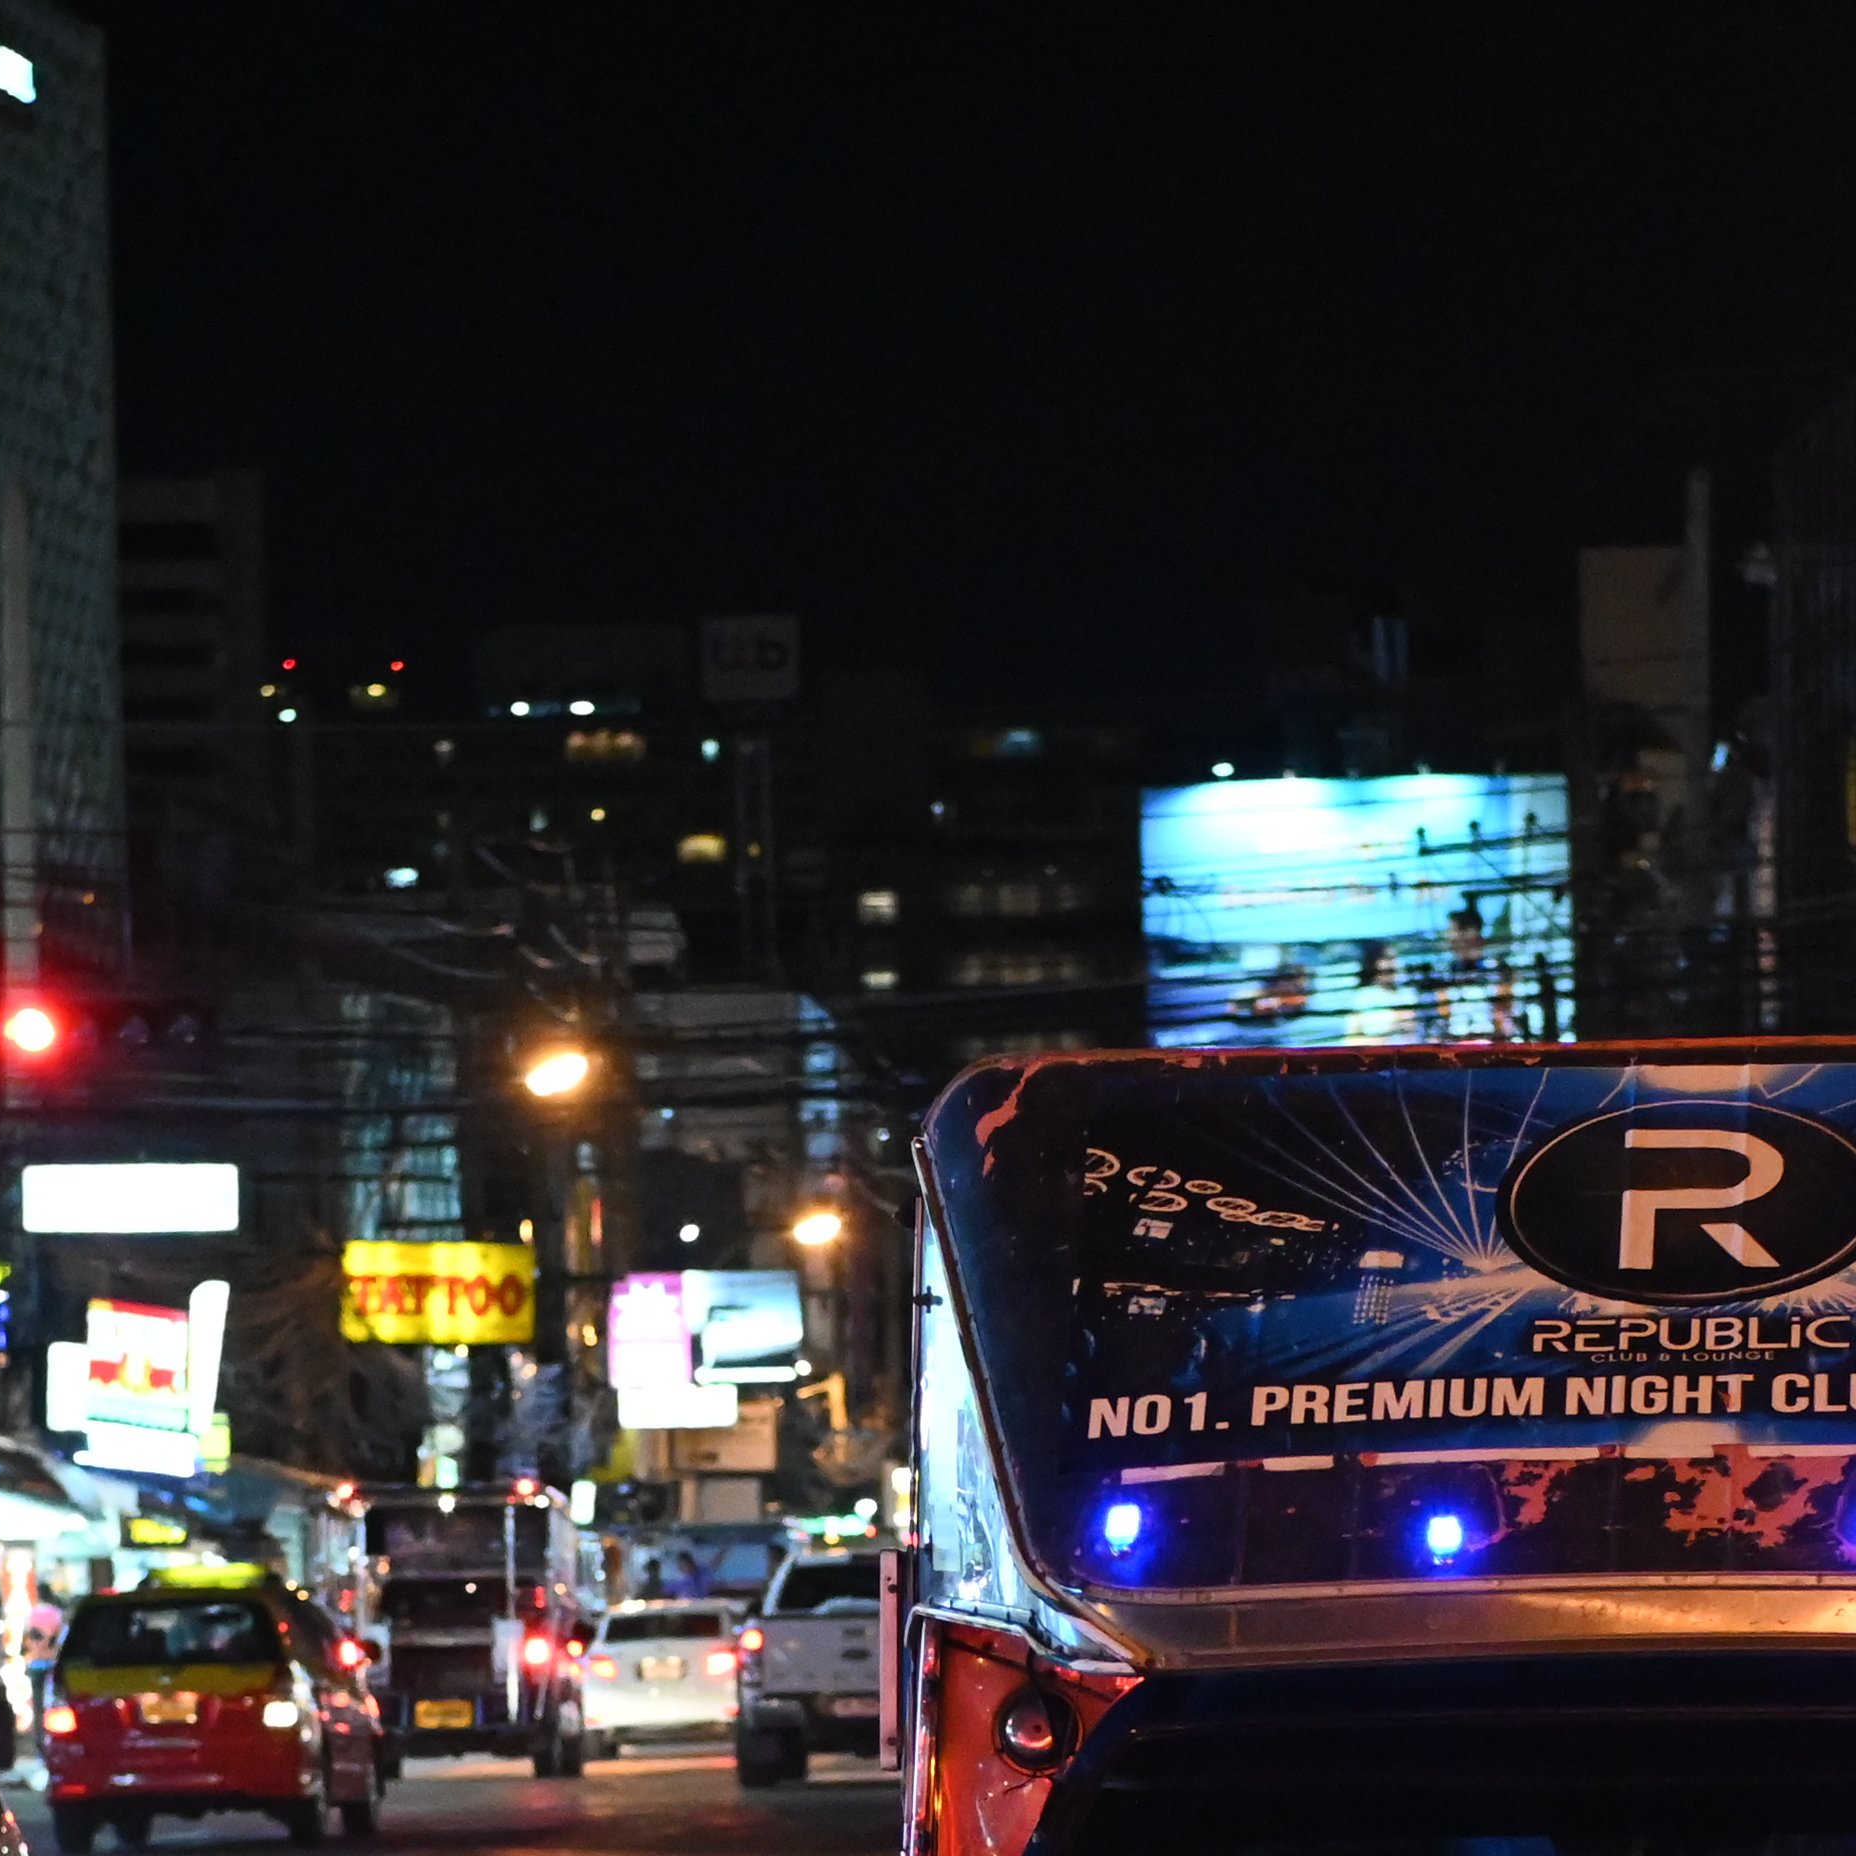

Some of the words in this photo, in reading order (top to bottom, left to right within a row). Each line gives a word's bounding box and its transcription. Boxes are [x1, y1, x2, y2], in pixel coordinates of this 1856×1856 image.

[1618, 1128, 1785, 1270] R
[347, 1274, 525, 1317] TATTOO
[1590, 1352, 1648, 1364] CLUB
[1681, 1350, 1775, 1363] LOUNGE
[1250, 1376, 1545, 1427] PREMIUM
[1565, 1373, 1754, 1416] NIGHT
